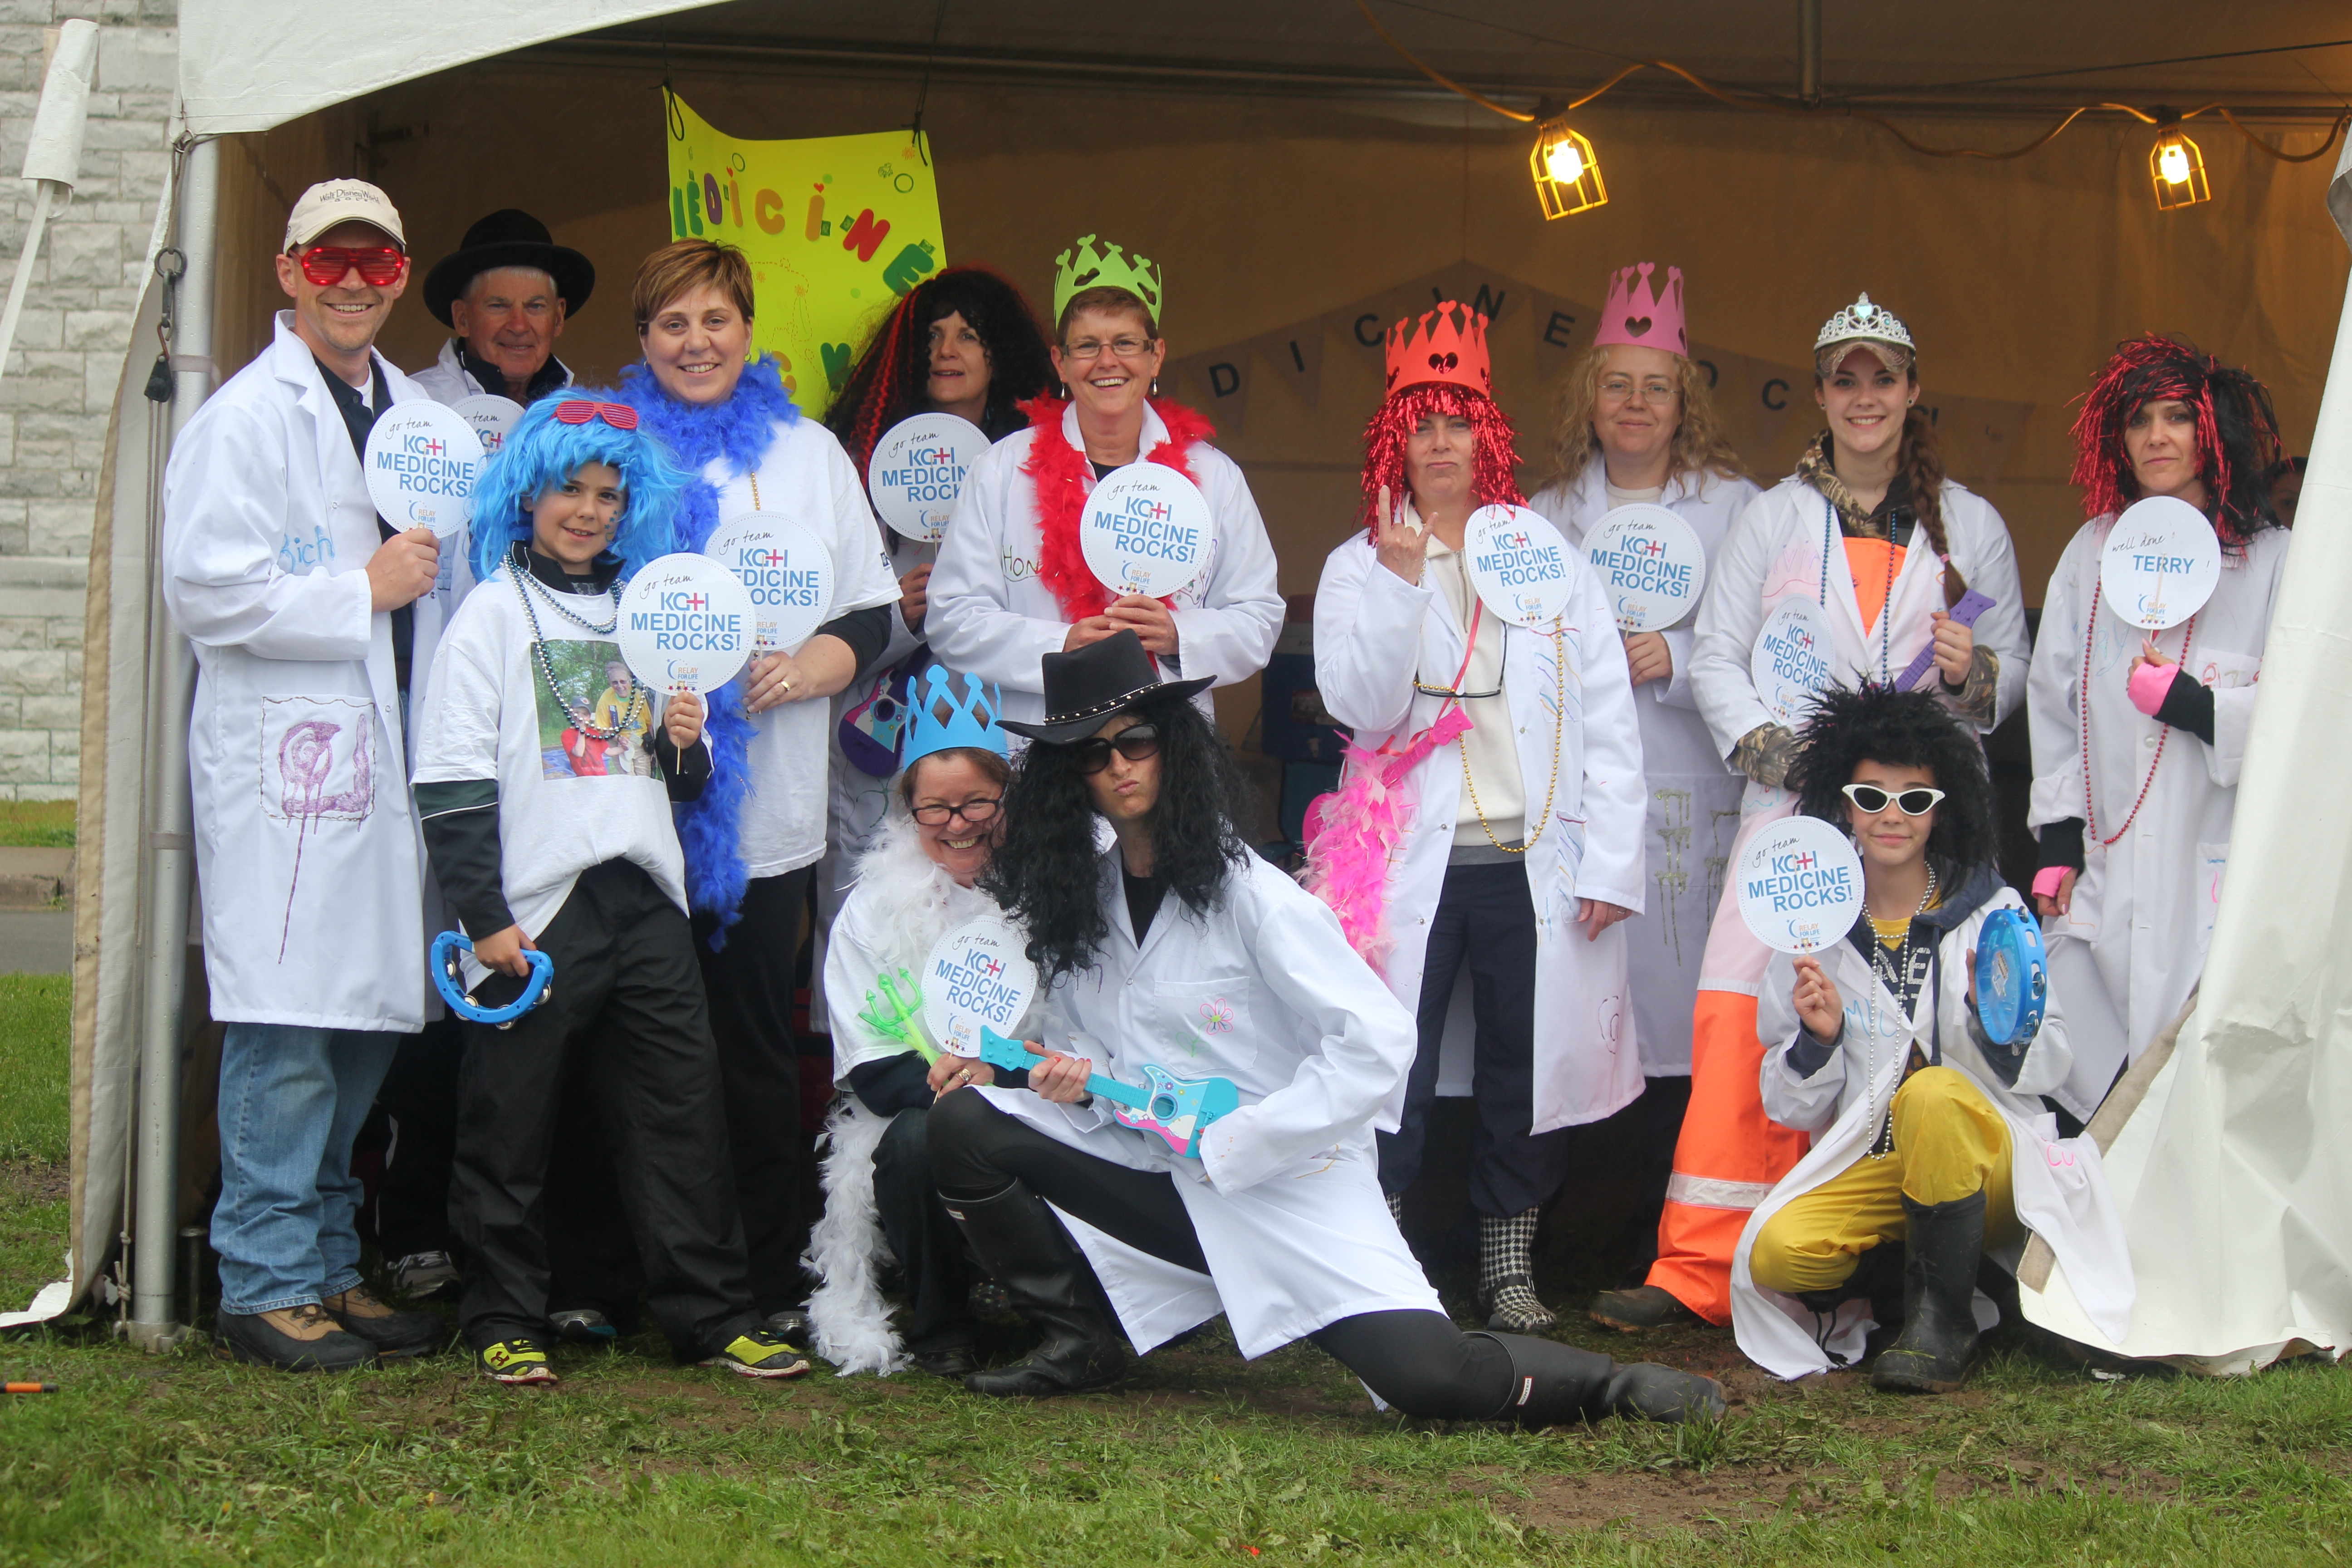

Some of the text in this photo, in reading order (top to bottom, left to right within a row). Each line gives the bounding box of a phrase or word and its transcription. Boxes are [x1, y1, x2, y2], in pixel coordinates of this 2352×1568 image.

[320, 191, 334, 202] Walt
[336, 189, 363, 200] Disney
[473, 411, 501, 423] team
[385, 417, 433, 440] go team
[888, 432, 940, 458] go team
[377, 451, 474, 480] MEDICINE
[882, 465, 970, 486] MEDICIN
[907, 484, 960, 502] ROCK
[1107, 480, 1161, 500] go team
[418, 509, 436, 517] RELAY
[1094, 511, 1199, 546] MEDICINE
[1488, 519, 1511, 532] team
[1604, 519, 1657, 539] go team
[719, 530, 774, 555] go team
[1115, 534, 1196, 564] ROCKS!
[2112, 534, 2166, 553] well done
[1477, 545, 1562, 573] MEDICINE
[1591, 549, 1692, 583] MEDICINE
[2132, 554, 2195, 574] TERRY
[729, 568, 819, 588] DICINE
[1132, 569, 1151, 578] RELAY
[1499, 563, 1566, 587] ROCKS!
[639, 573, 694, 599] go team
[1611, 570, 1689, 599] ROCKS!
[750, 588, 819, 607] OCKS!
[631, 612, 741, 632] MEDICINE
[1793, 608, 1809, 622] team
[656, 632, 740, 651] ROCKS!
[1763, 633, 1828, 679] MEDICINE
[1752, 837, 1801, 868] go team
[1748, 866, 1851, 899] MEDICINE
[1773, 885, 1853, 913] ROCKS!
[1799, 923, 1819, 931] RELAY
[951, 932, 1001, 950] go team
[935, 959, 1021, 1009] MEDICINE
[946, 985, 1013, 1026] ROCKS!
[953, 1029, 970, 1041] FOR LIFE
[955, 1023, 972, 1035] RELAY
[1519, 1379, 1530, 1404] HUNTER
